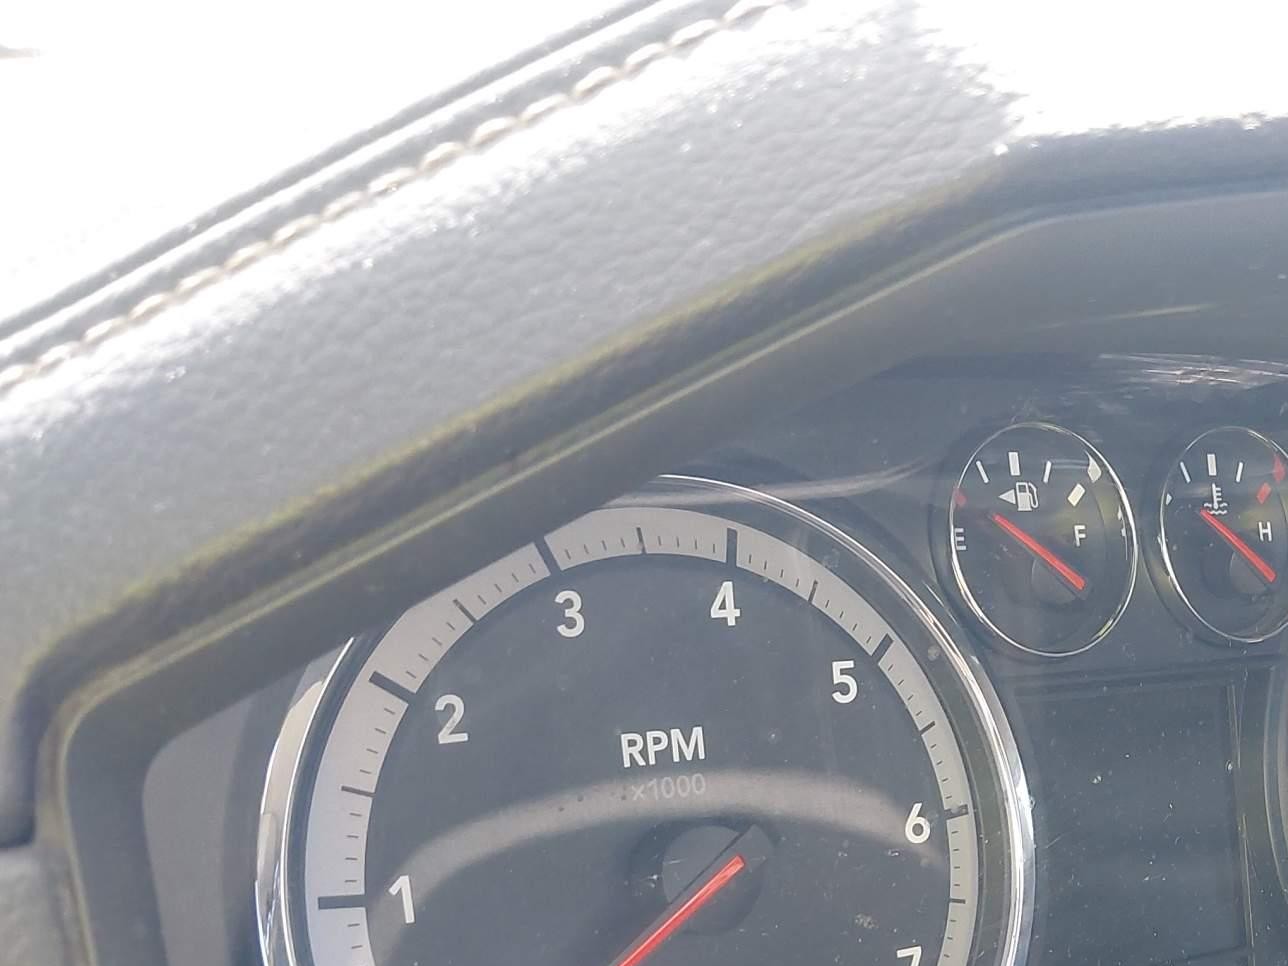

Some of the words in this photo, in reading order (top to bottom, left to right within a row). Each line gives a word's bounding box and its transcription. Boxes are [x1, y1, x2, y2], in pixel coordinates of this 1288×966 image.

[954, 527, 967, 550] E
[1074, 524, 1086, 547] F
[1258, 521, 1272, 542] H
[554, 590, 585, 638] 3
[710, 581, 741, 626] 4
[831, 660, 859, 704] 5
[434, 694, 469, 744] 2
[621, 726, 706, 768] RPM
[903, 802, 931, 844] 6
[388, 875, 415, 924] 1
